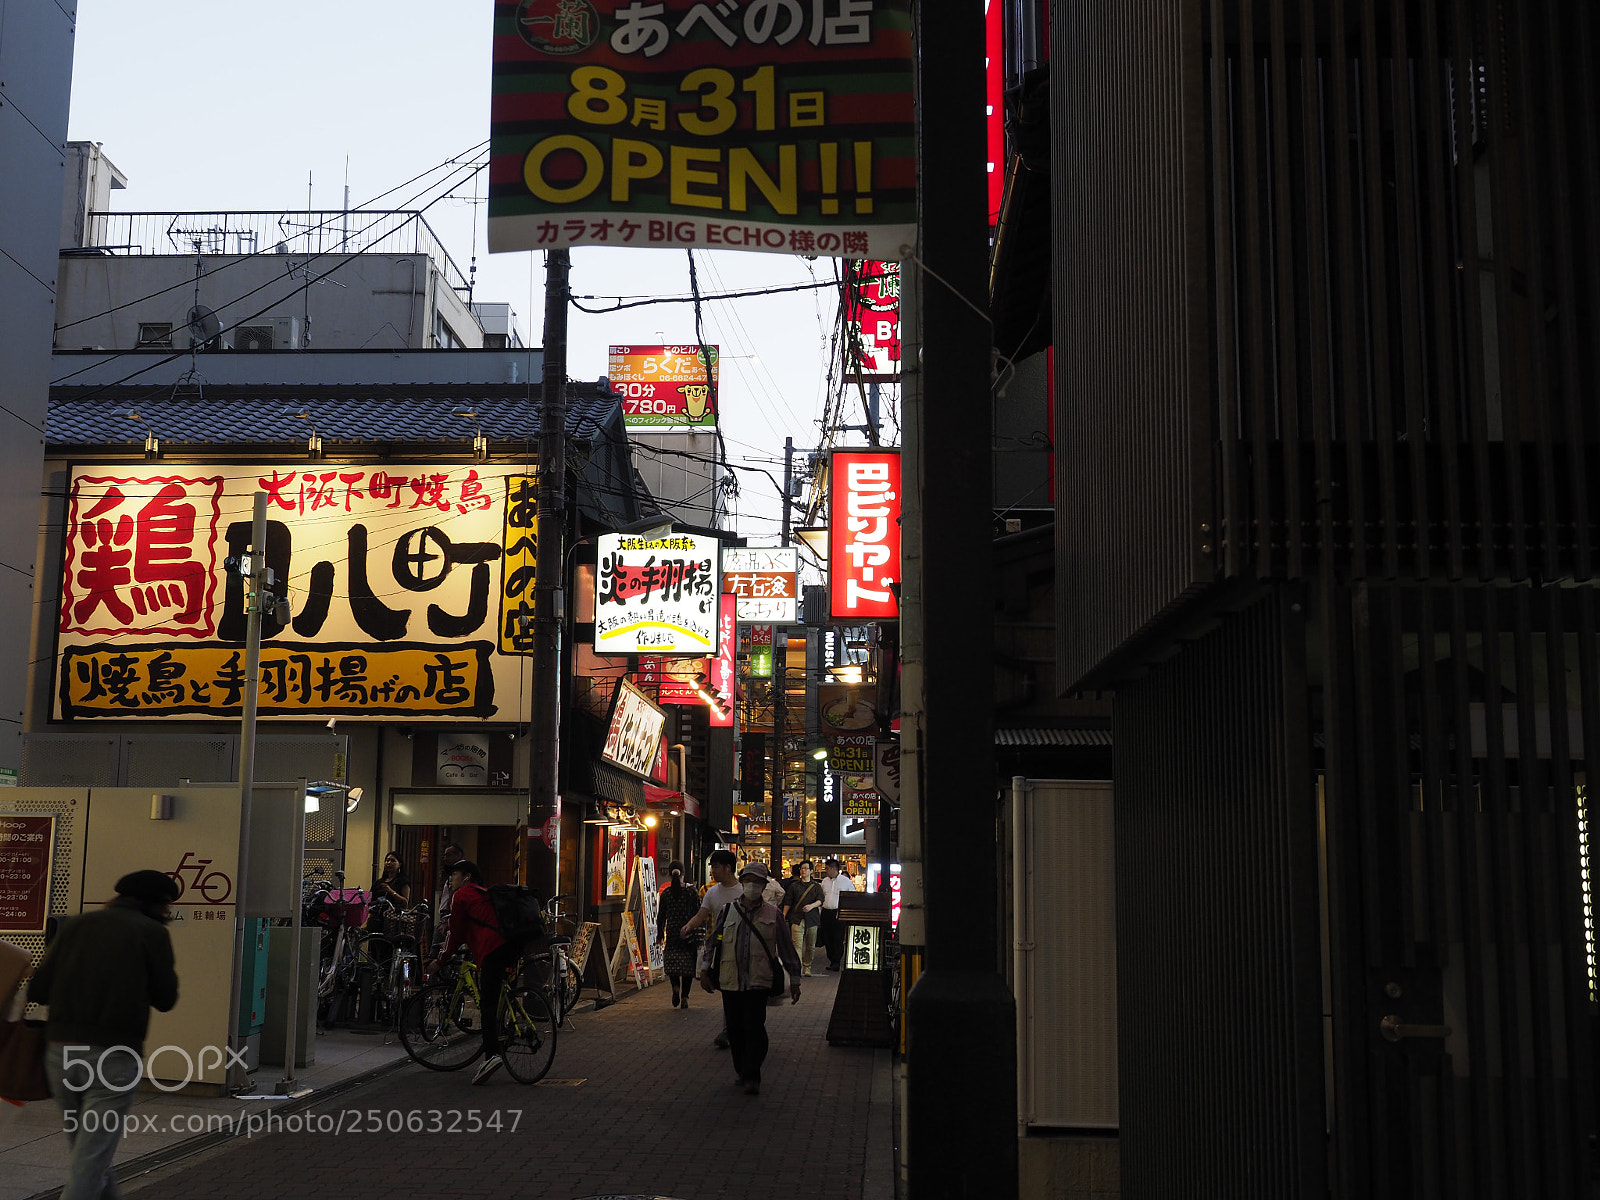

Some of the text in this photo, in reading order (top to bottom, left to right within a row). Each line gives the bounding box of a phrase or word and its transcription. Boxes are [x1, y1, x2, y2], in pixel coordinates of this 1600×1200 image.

[609, 0, 875, 57] あべの店
[566, 64, 825, 136] 8月31日
[523, 134, 874, 216] OPEN!!
[609, 373, 645, 381] もみほぐし
[643, 357, 691, 374] らくだ
[615, 383, 656, 398] 30分
[256, 469, 493, 516] 大阪下町焼鳥
[505, 479, 536, 651] あべの店
[636, 630, 675, 645] 作りました
[75, 650, 473, 708] 焼鳥と手羽揚げの店
[836, 735, 876, 745] あべの店
[192, 910, 227, 921] 駐輪場
